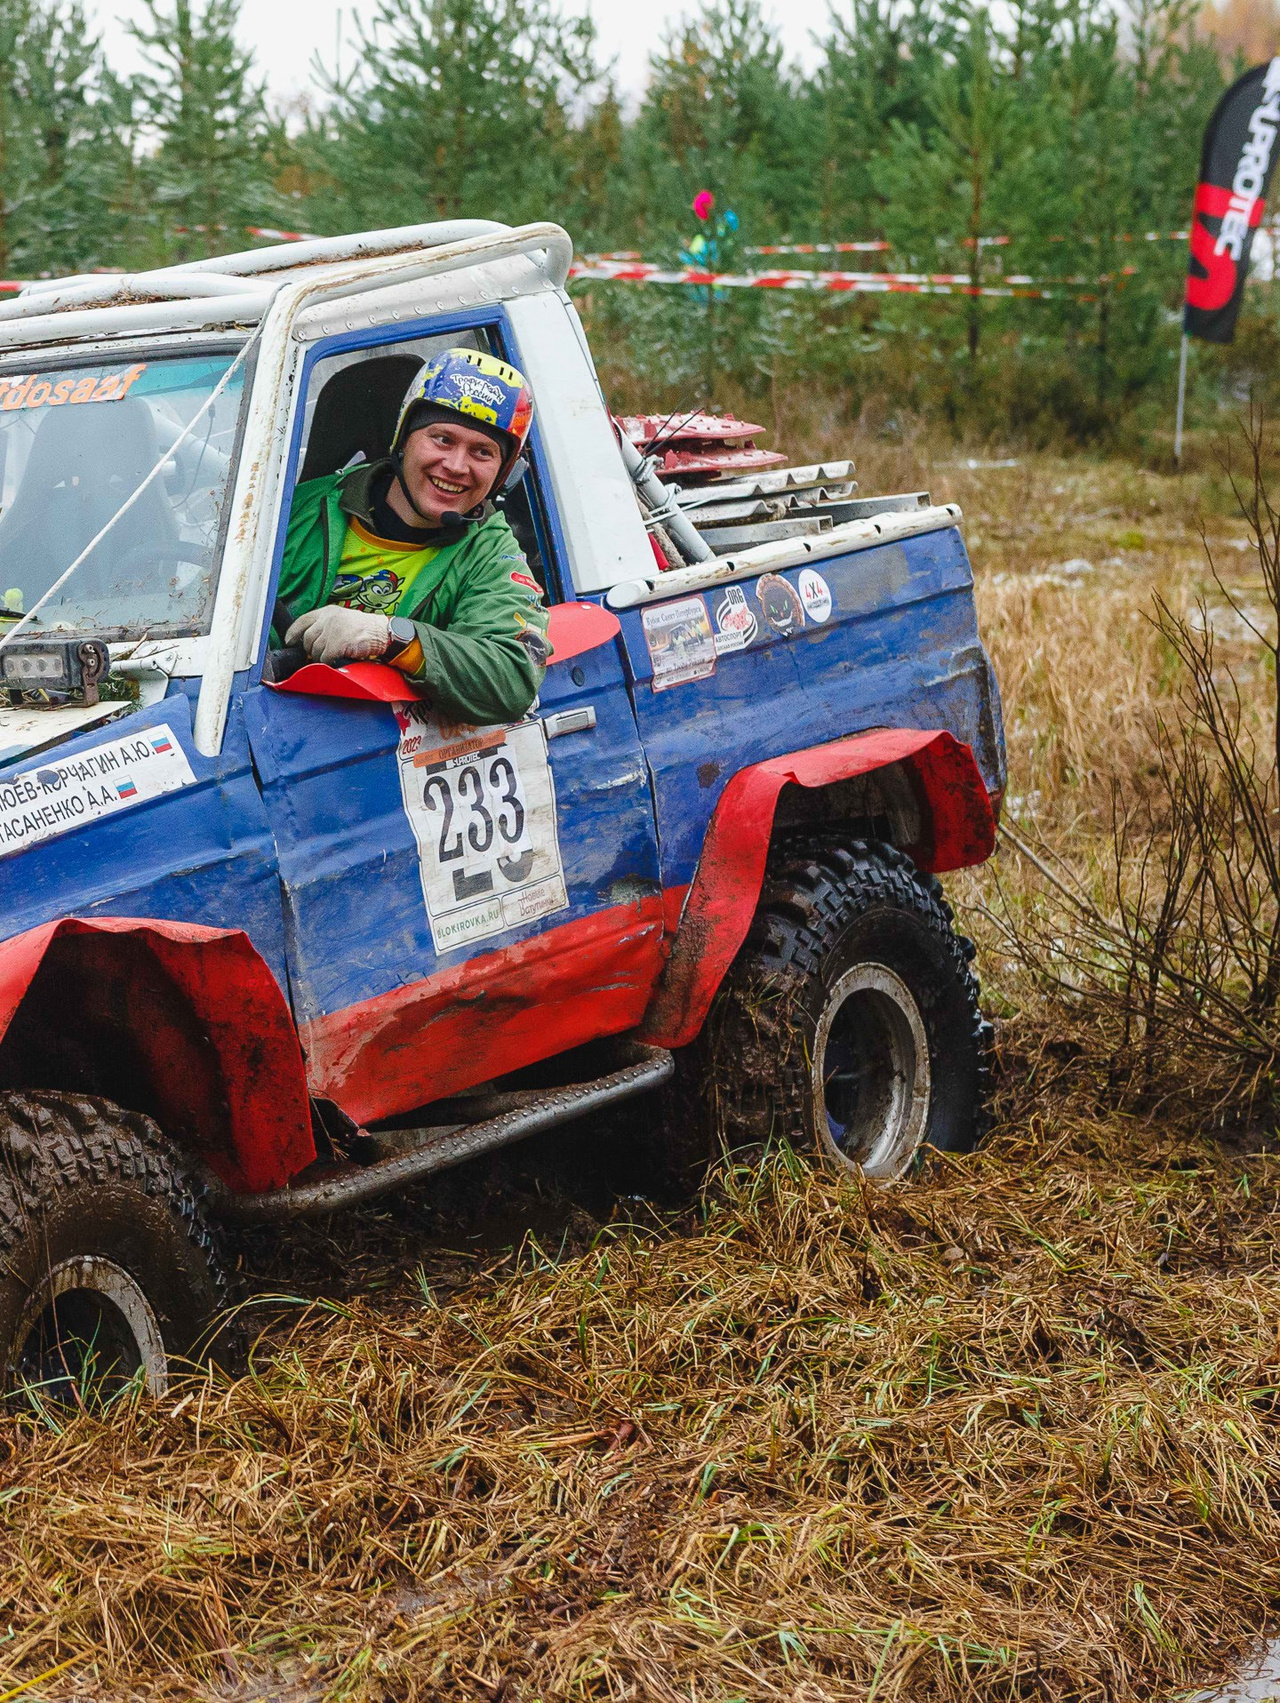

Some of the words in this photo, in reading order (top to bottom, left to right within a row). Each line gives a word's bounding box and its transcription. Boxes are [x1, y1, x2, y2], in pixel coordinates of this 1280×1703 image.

[727, 589, 744, 604] ORG
[122, 740, 156, 766] А.Ю.
[87, 786, 118, 810] А.А.
[423, 757, 525, 864] 233
[436, 909, 500, 939] BLOKIROVKA.RU
